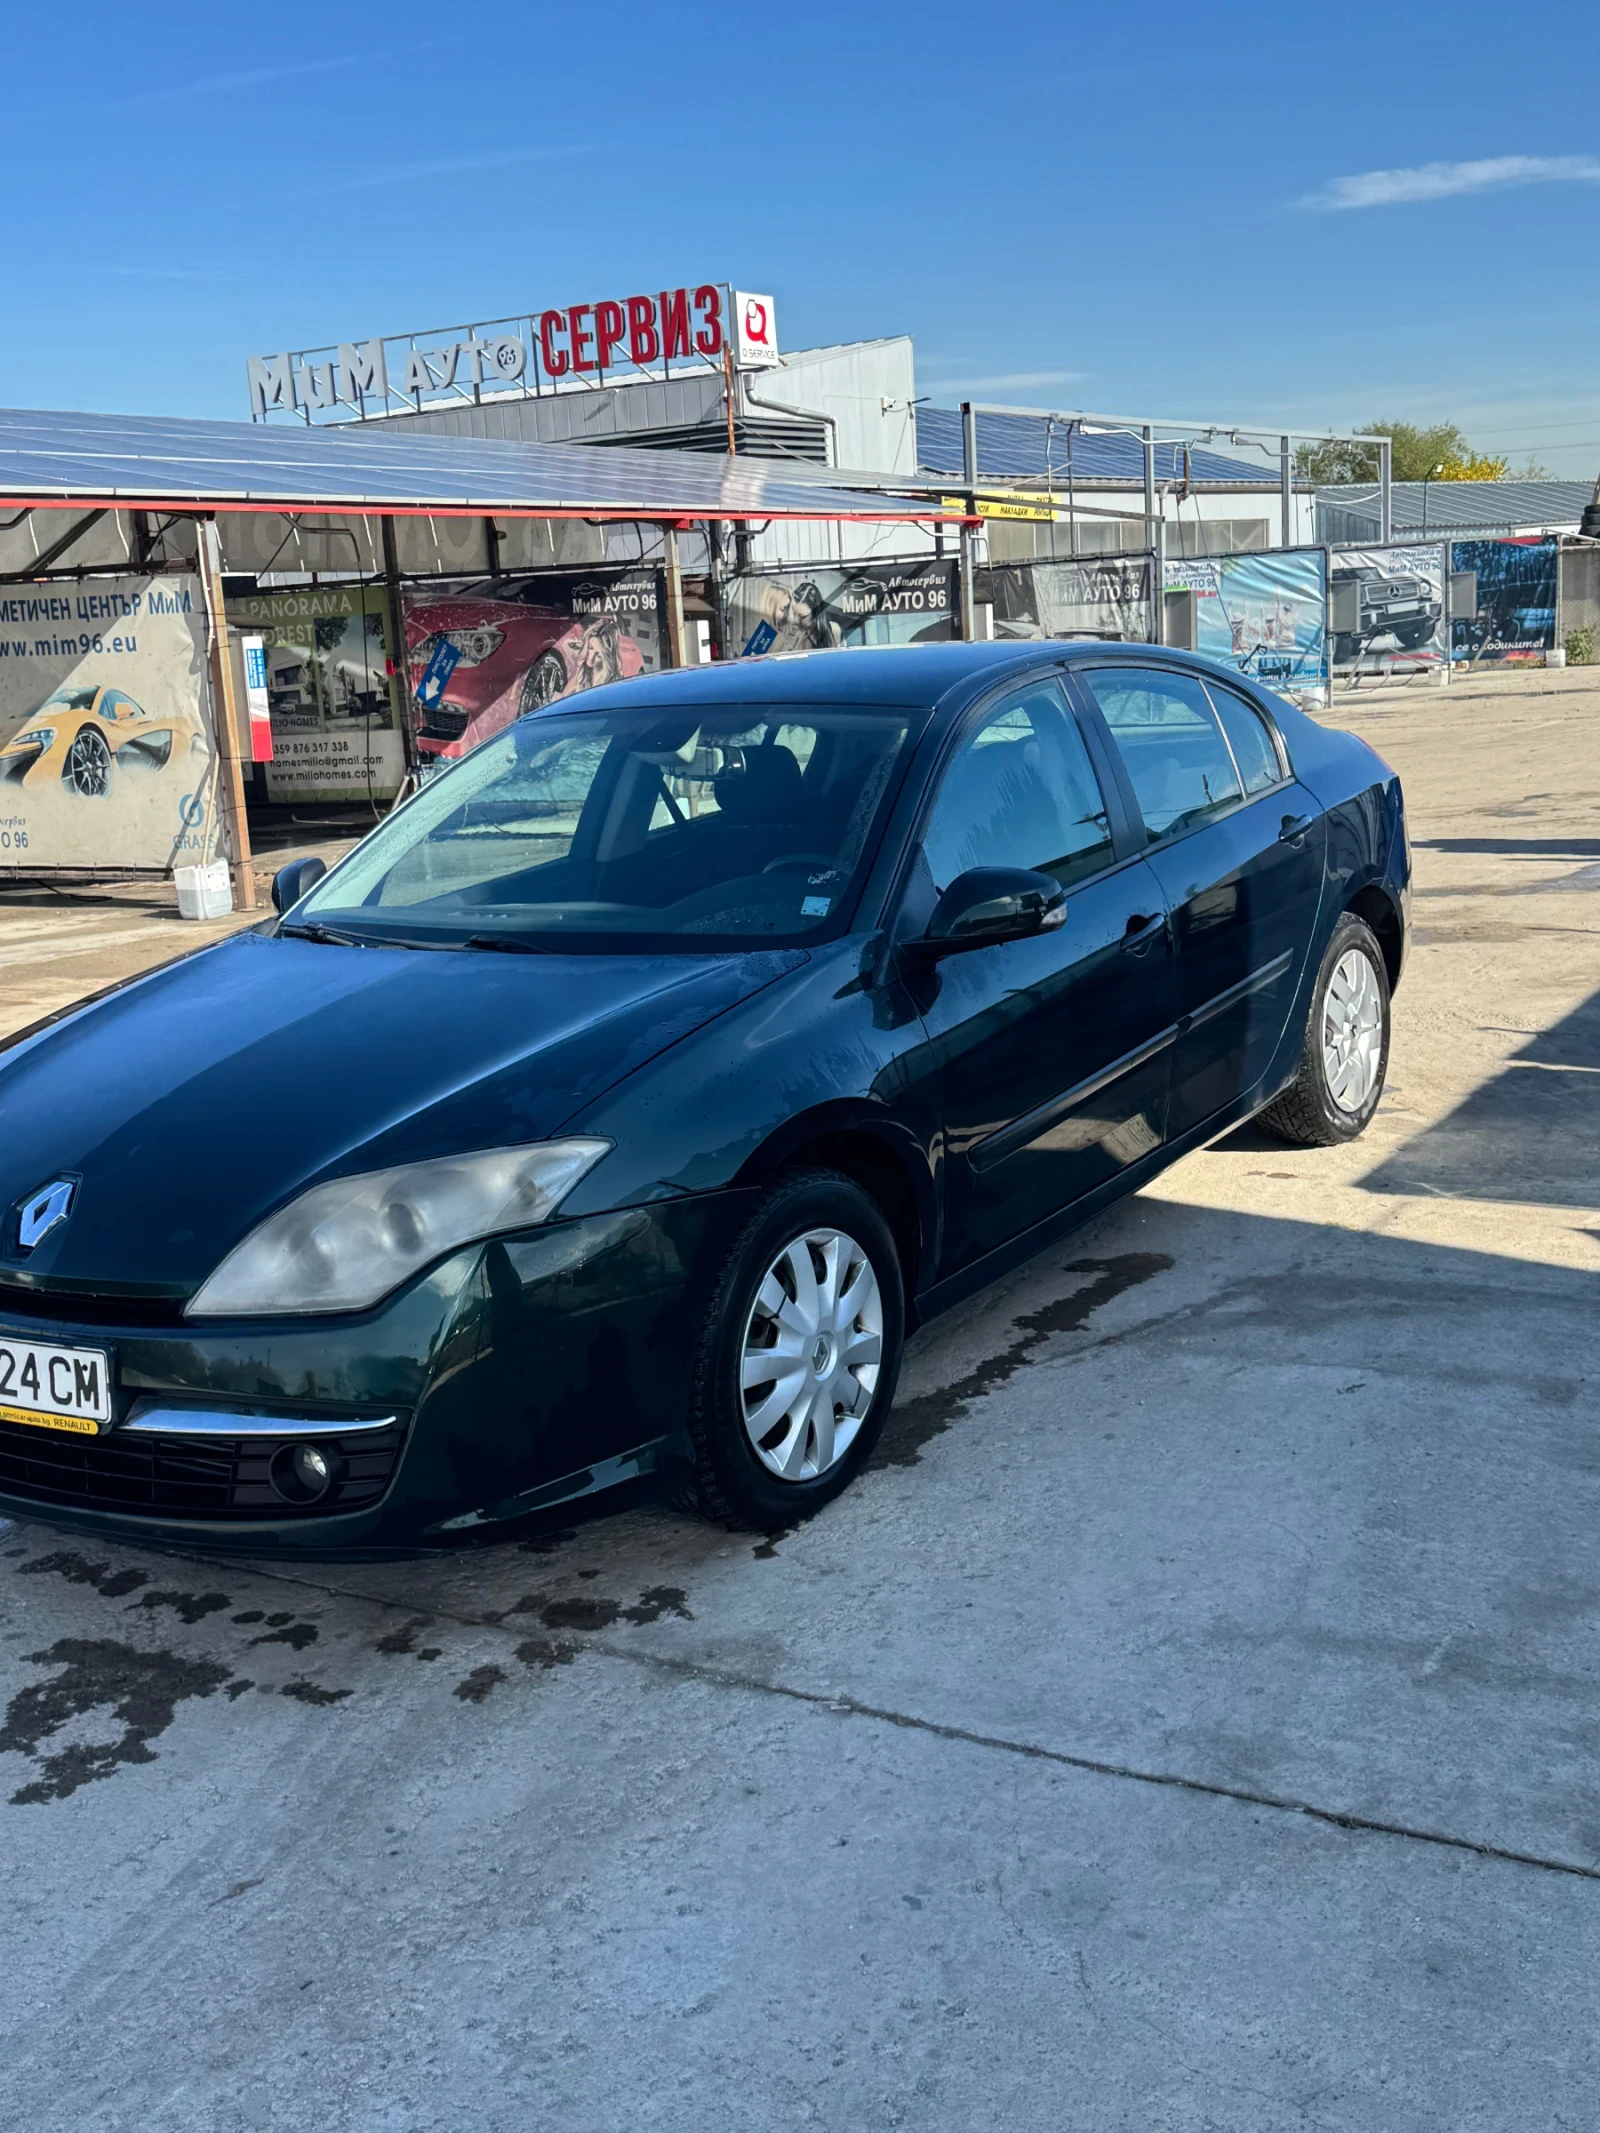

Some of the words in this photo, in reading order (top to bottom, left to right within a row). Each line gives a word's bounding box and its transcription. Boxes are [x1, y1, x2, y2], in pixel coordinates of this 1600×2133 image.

[540, 284, 724, 376] СЕРВИЗ
[497, 346, 516, 365] 96
[748, 348, 776, 360] SERVICE
[888, 574, 946, 588] Автосервиз
[842, 594, 877, 613] МиМ
[881, 591, 924, 611] АУТО
[928, 589, 947, 608] 96
[1083, 585, 1120, 602] АУТО
[1124, 583, 1140, 600] 96
[76, 593, 142, 622] ЦЕНТЪР
[148, 589, 191, 615] МиМ
[249, 594, 353, 619] PANORAMA
[572, 597, 601, 614] МиМ
[603, 594, 639, 612] АУТО
[641, 594, 657, 610] 96
[252, 624, 313, 645] OREST
[1483, 637, 1545, 650] одините!
[271, 718, 288, 728] ILIO
[291, 717, 319, 726] HOMES
[272, 745, 290, 755] 359
[293, 743, 310, 754] 876
[312, 742, 328, 752] 317
[331, 741, 349, 752] 338
[14, 831, 29, 849] 96
[173, 834, 216, 850] GRASS
[0, 1348, 41, 1401] 24
[48, 1355, 100, 1411] CM
[53, 1417, 92, 1431] RENAULT
